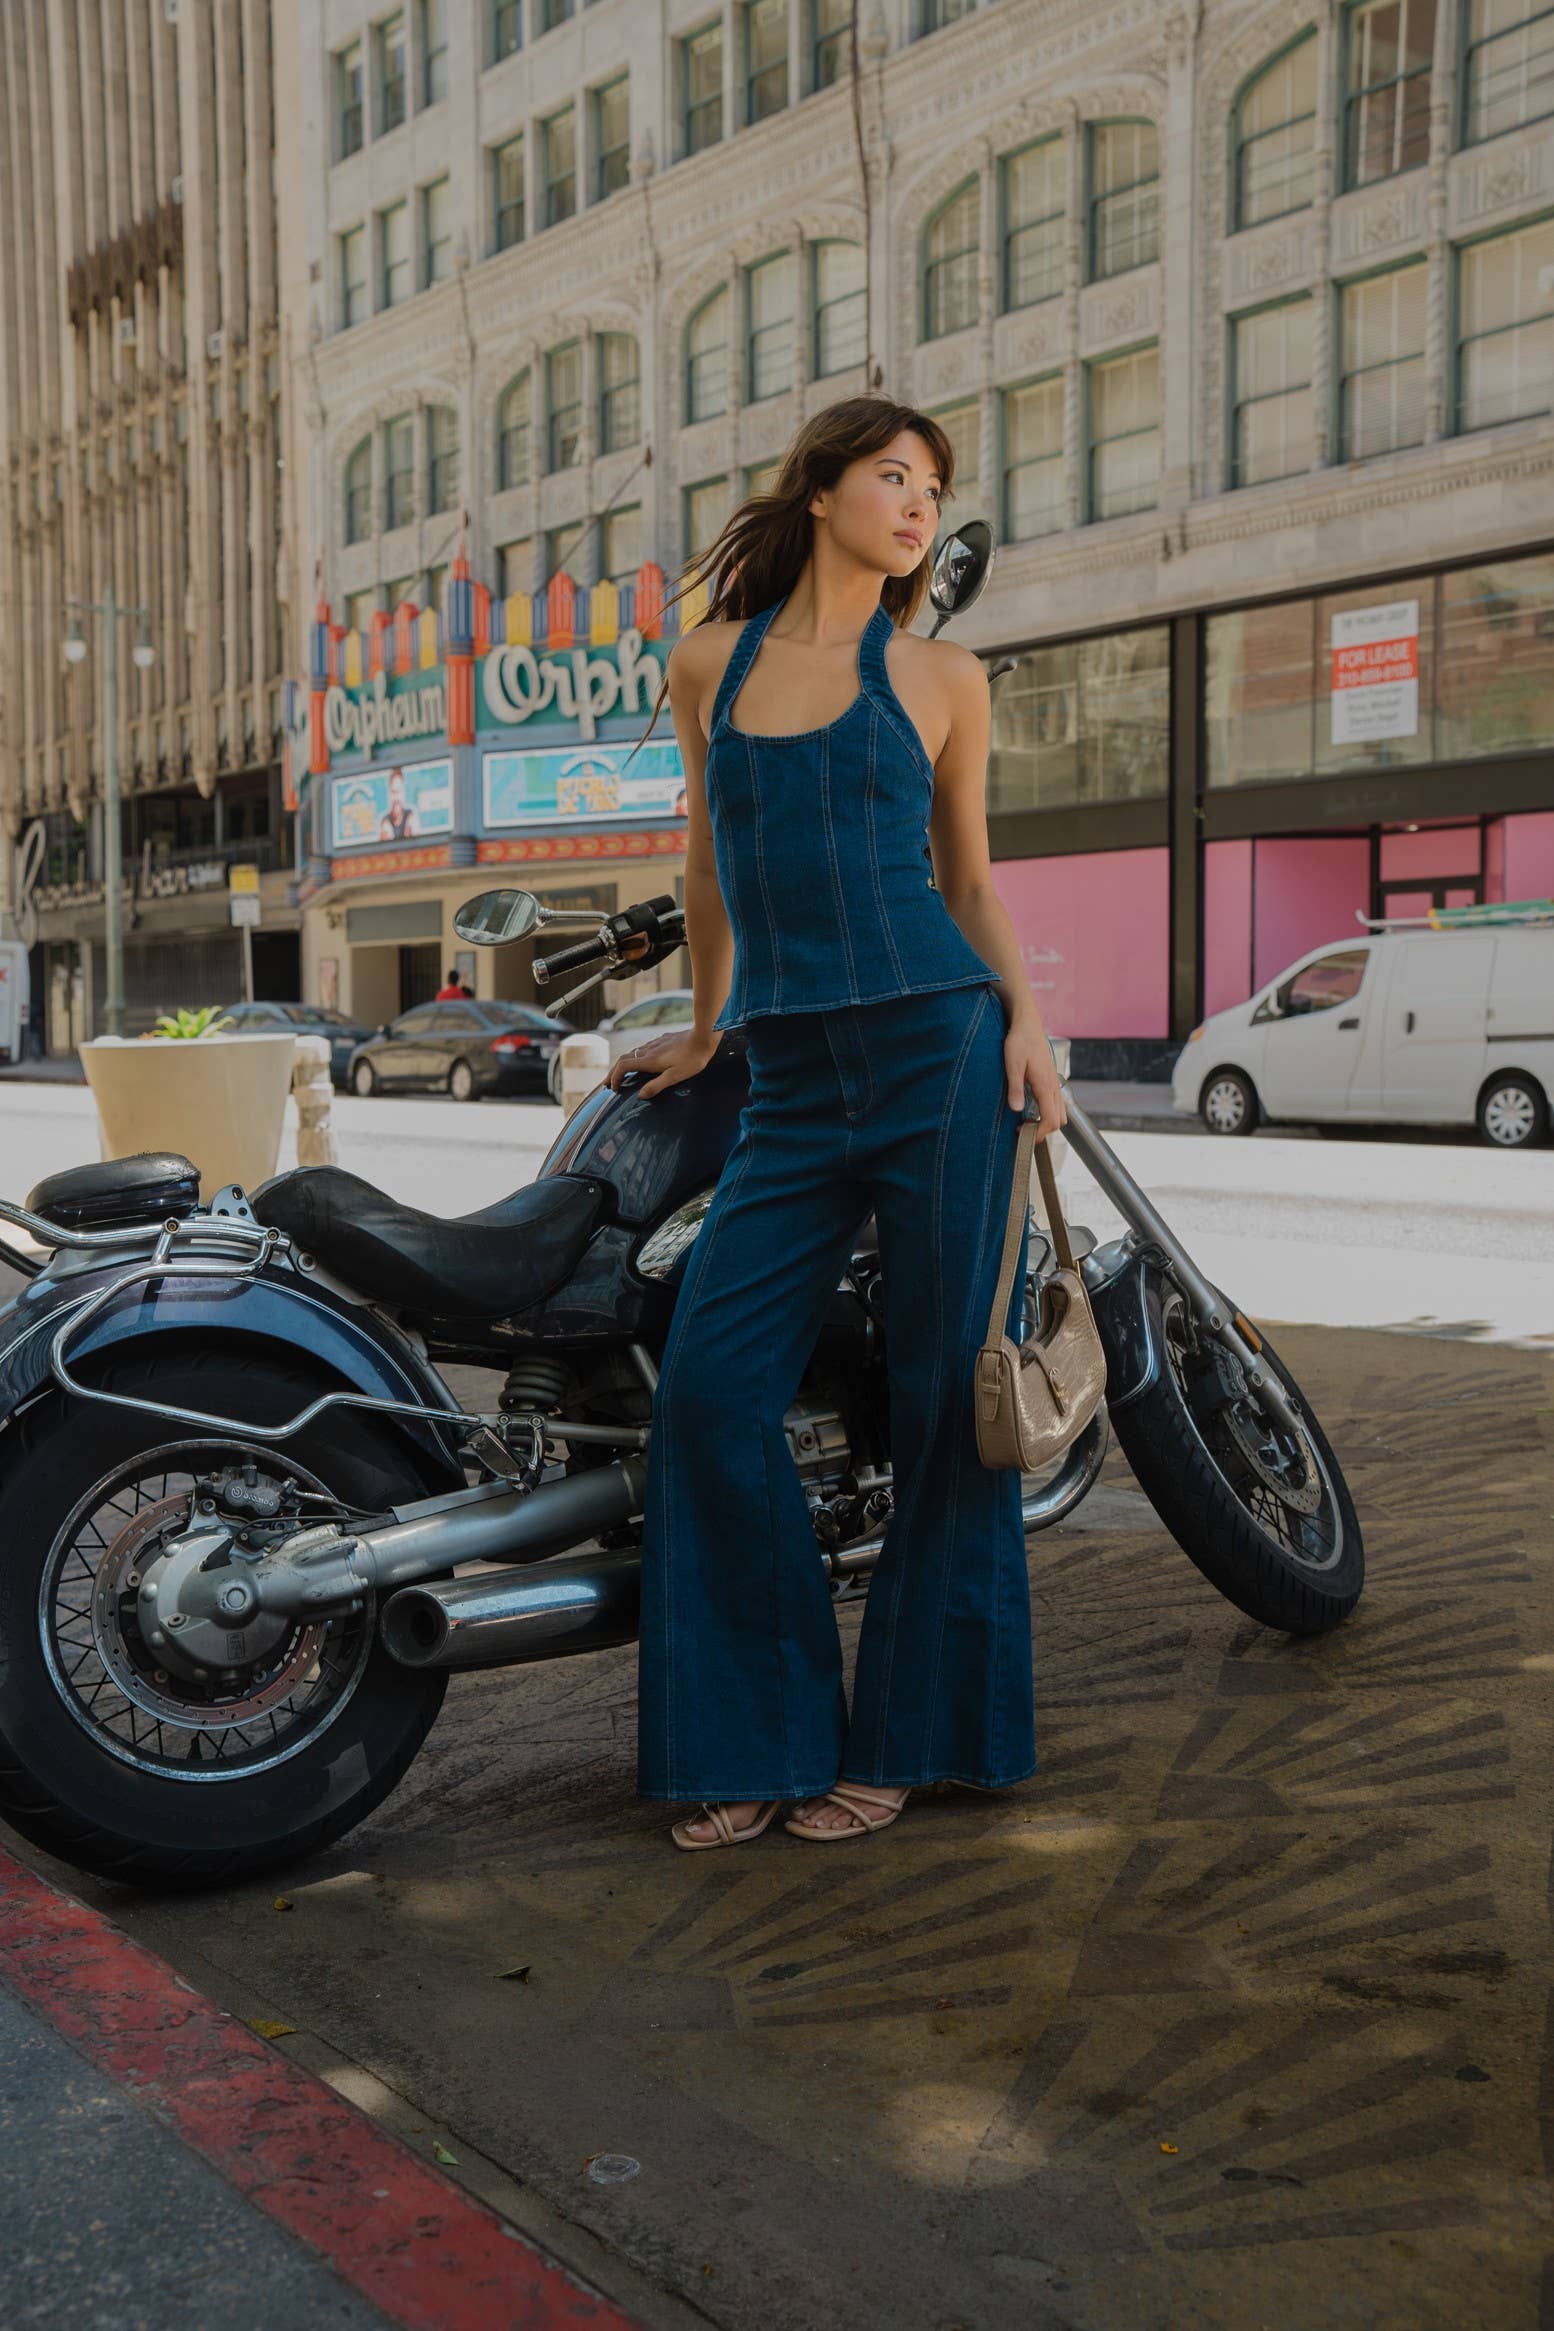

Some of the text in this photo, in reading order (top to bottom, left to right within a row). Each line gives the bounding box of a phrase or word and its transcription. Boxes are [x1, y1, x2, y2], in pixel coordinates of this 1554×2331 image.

[484, 628, 672, 740] Orph
[1338, 641, 1409, 669] FOR LEASE
[324, 671, 449, 762] Orpheum
